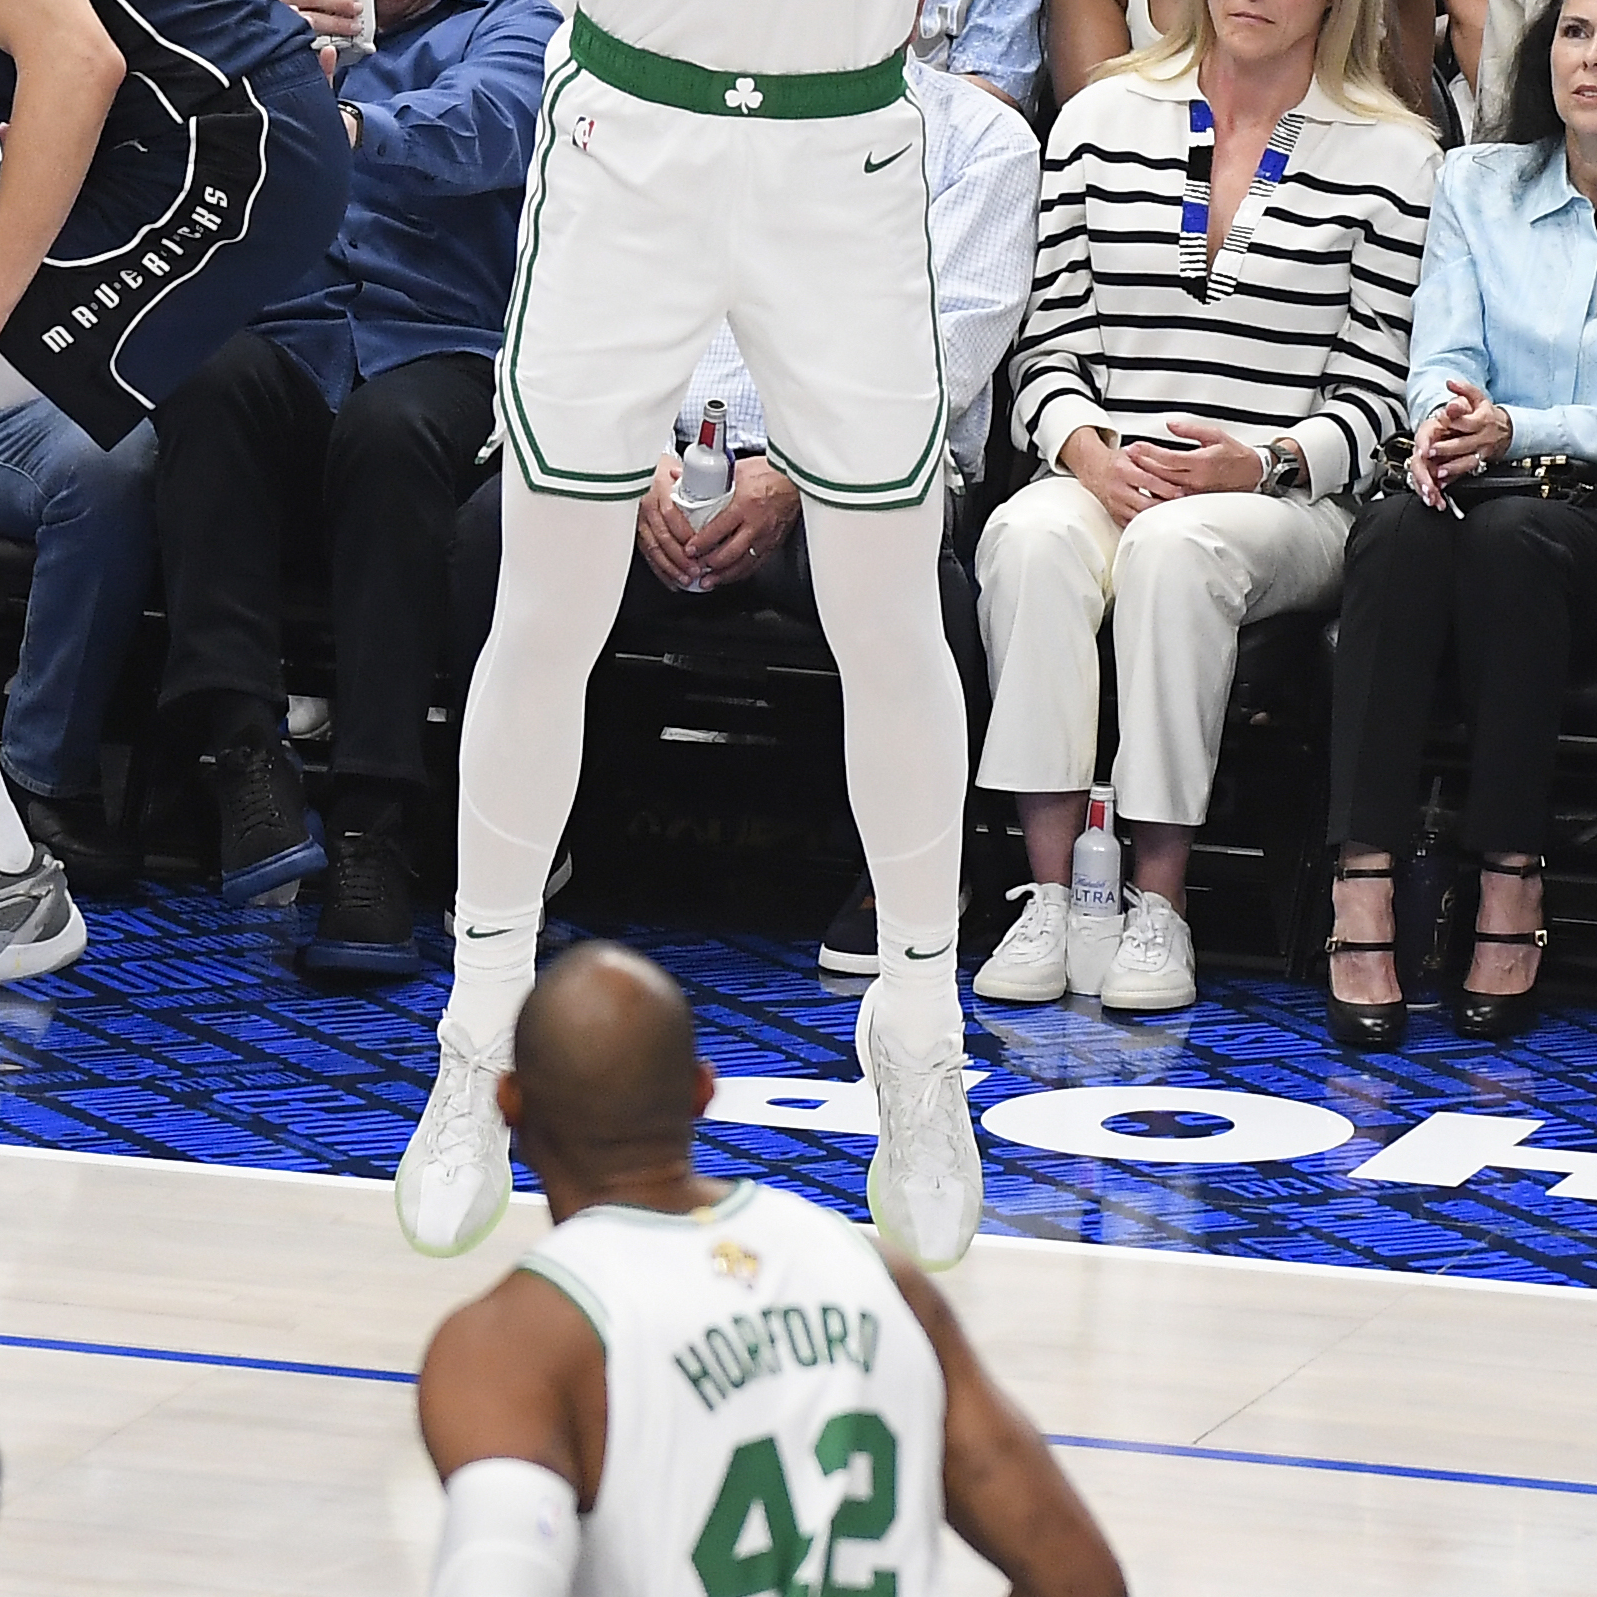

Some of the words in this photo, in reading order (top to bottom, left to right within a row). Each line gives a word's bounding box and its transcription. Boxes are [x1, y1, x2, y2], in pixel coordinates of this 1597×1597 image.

[1070, 886, 1118, 905] LTRA
[1211, 1176, 1309, 1199] EXEL
[672, 1300, 880, 1413] HORFORD
[692, 1409, 899, 1597] 42
